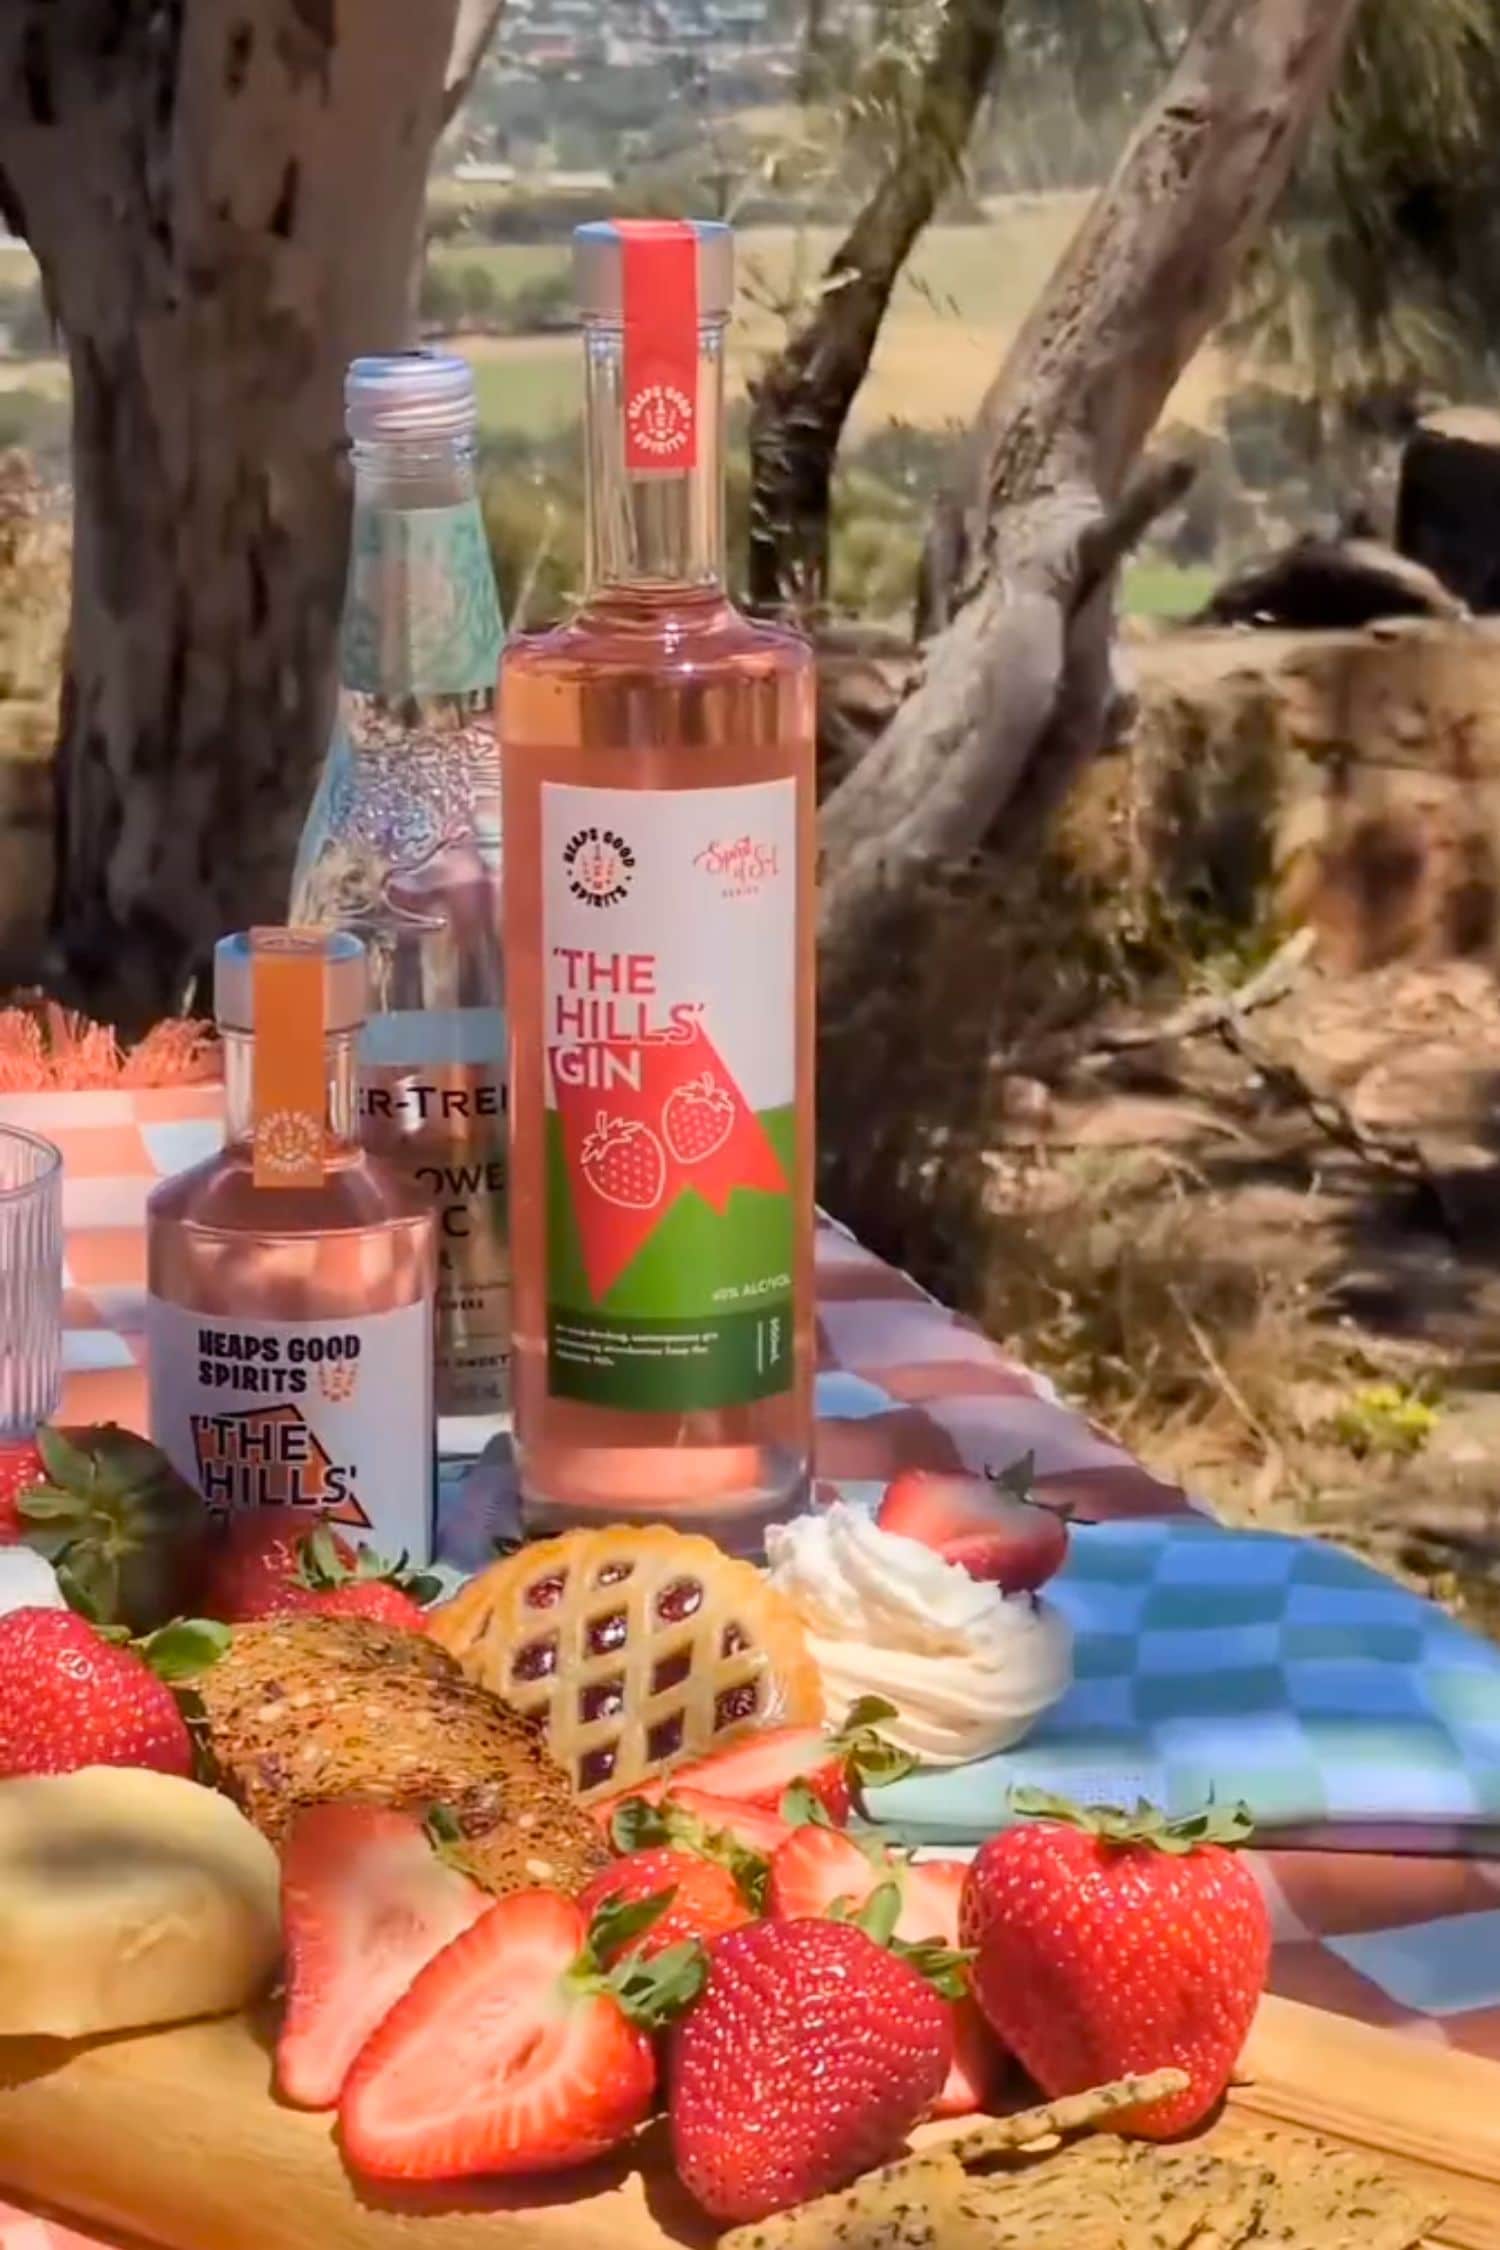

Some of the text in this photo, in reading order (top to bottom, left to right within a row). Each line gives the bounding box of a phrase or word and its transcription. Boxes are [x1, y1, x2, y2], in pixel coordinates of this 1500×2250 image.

[563, 826, 636, 868] HEAPS GOOD
[569, 881, 628, 908] SPIRITS
[198, 1329, 361, 1363] HEAPS GOOD
[199, 1361, 307, 1393] SPIRITS
